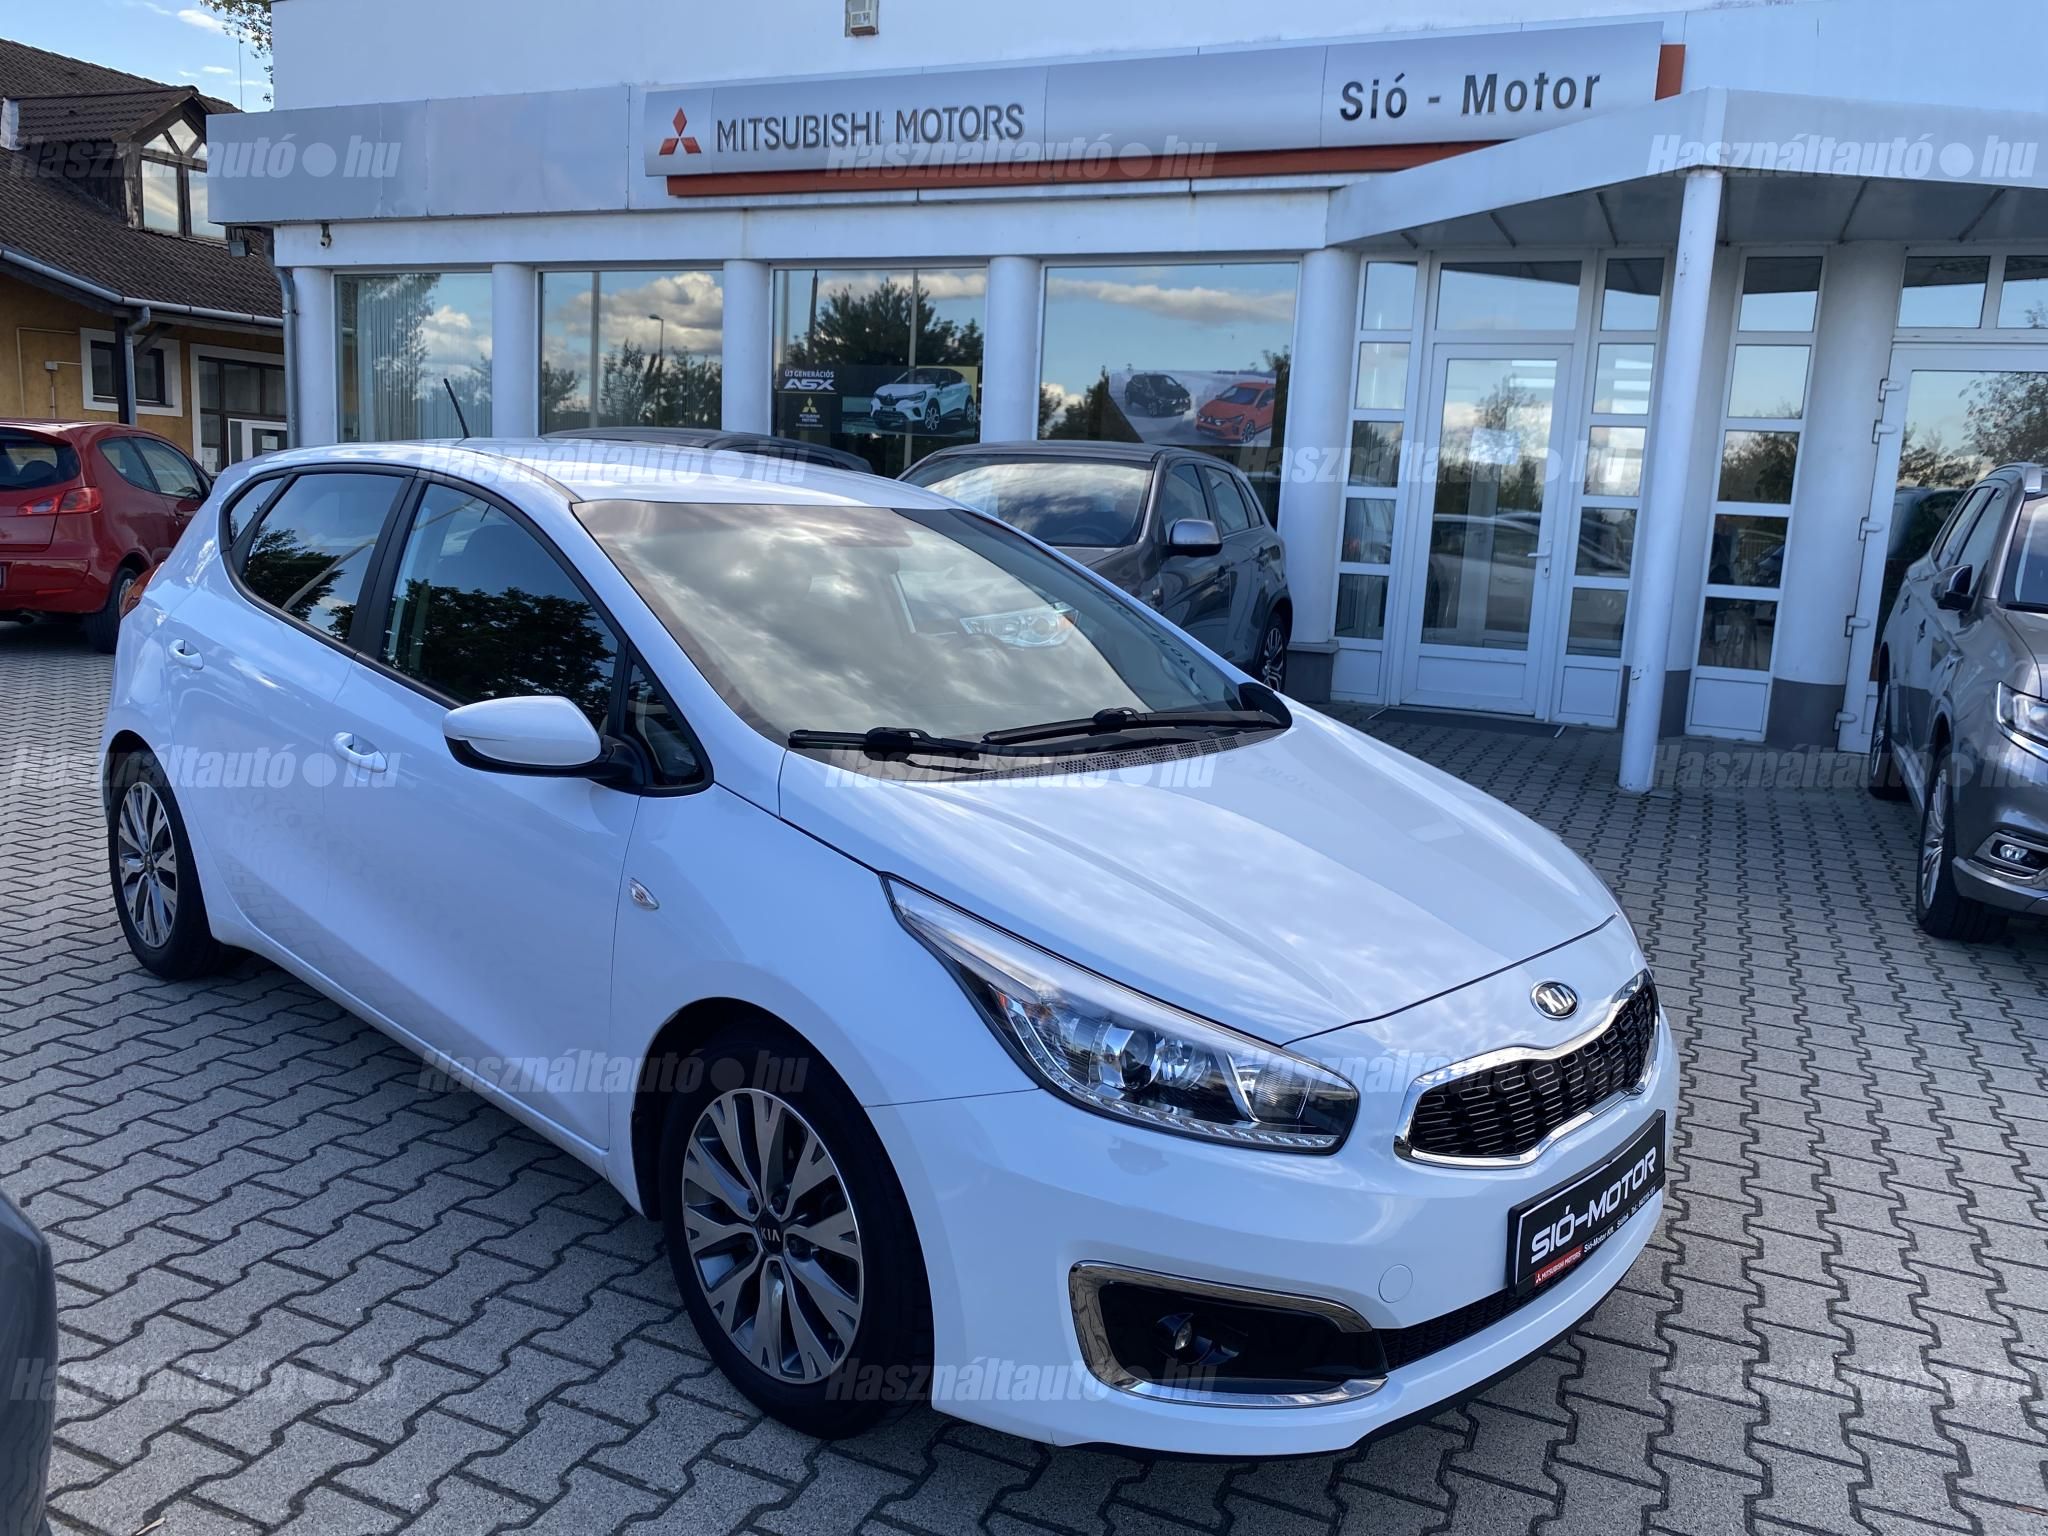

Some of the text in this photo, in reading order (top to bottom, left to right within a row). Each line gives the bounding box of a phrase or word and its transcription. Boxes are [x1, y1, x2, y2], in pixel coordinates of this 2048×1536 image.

[1339, 72, 1408, 121] Sió
[1460, 71, 1601, 117] Motor
[716, 103, 1025, 153] MITSUBISHI MOTORS
[784, 378, 835, 390] ASX
[1537, 984, 1577, 1013] KIA
[1530, 1146, 1657, 1264] SIÓ-MOTOR
[760, 1226, 781, 1242] KIA
